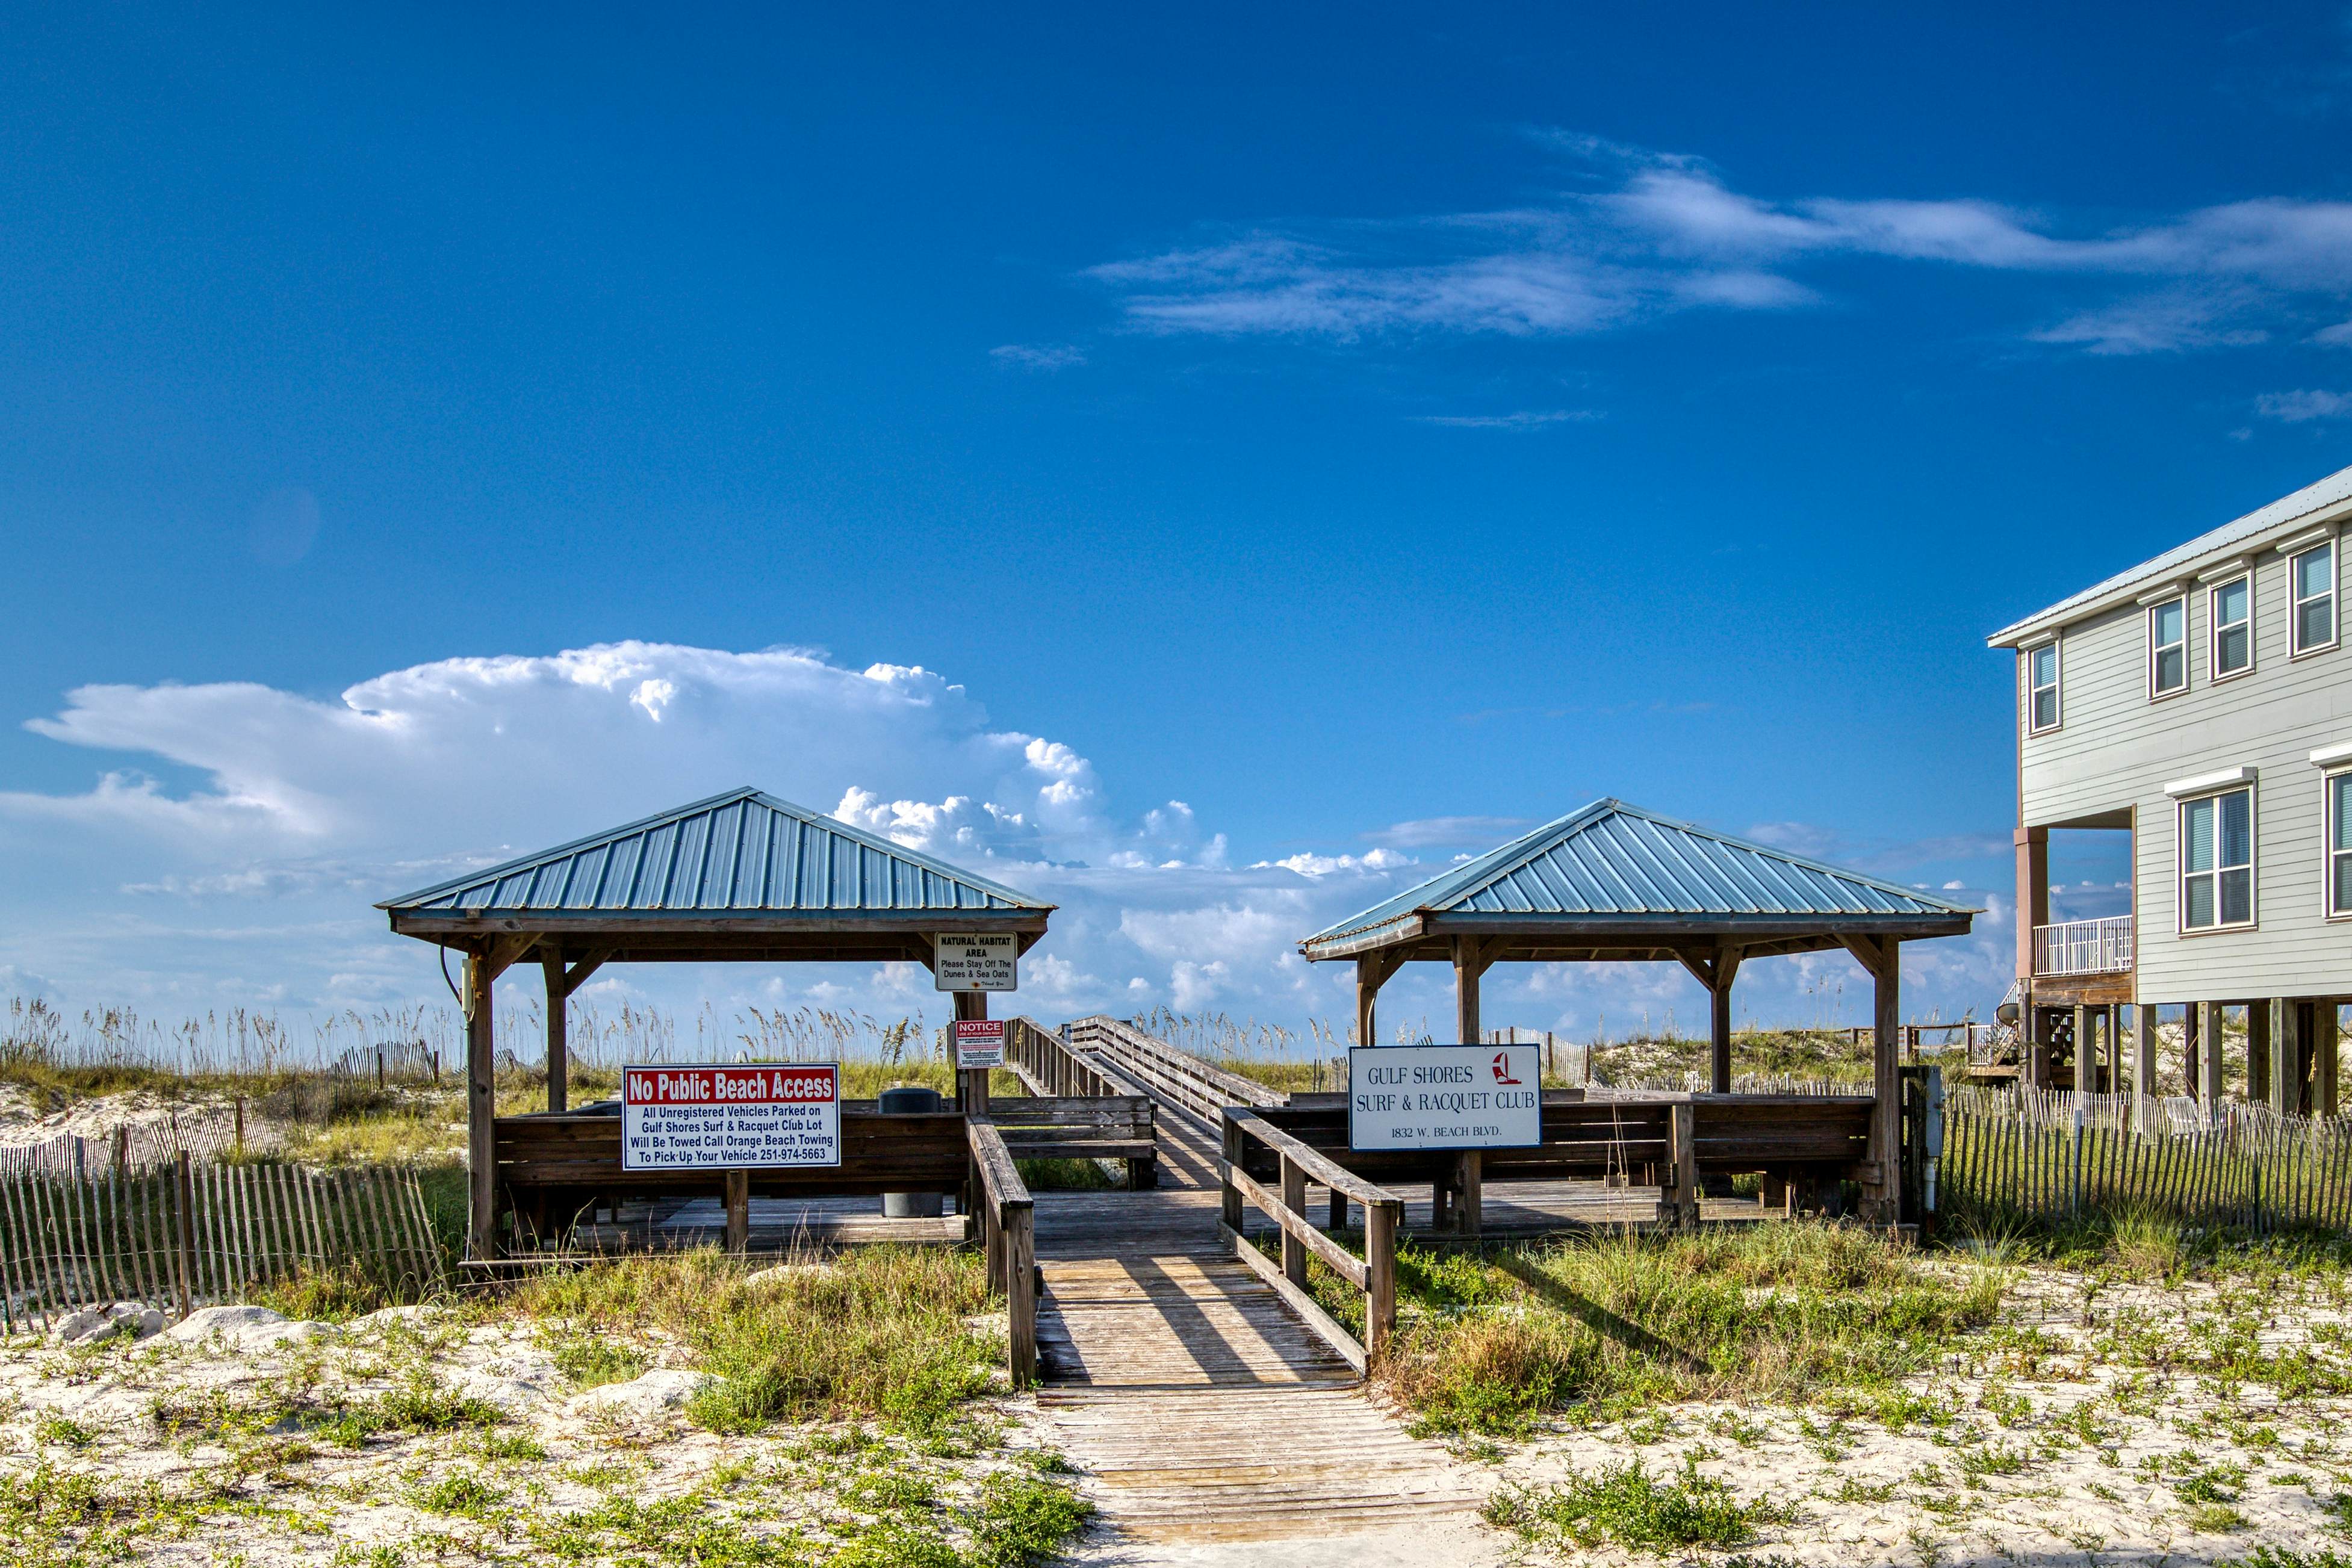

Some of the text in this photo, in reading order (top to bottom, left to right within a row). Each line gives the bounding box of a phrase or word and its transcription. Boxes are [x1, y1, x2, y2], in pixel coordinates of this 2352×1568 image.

[967, 960, 982, 968] Stay
[1368, 1066, 1473, 1085] GULF SHORES
[630, 1073, 832, 1100] No Public Beach Access
[1357, 1091, 1534, 1114] SURF & RACQUET CLUB
[643, 1108, 656, 1118] All
[660, 1106, 724, 1120] Unregistered
[727, 1106, 768, 1117] Vehicles
[772, 1105, 805, 1116] Parked
[642, 1120, 822, 1133] Gulf Shores Surf & Racquet Club Lot
[1392, 1126, 1501, 1138] 1832 W. BEACH BLVD.
[631, 1134, 833, 1148] Will Be Towed Call Orange Beach Towing
[639, 1148, 825, 1164] To Pick Up Your Vehicle 251-974-5663
